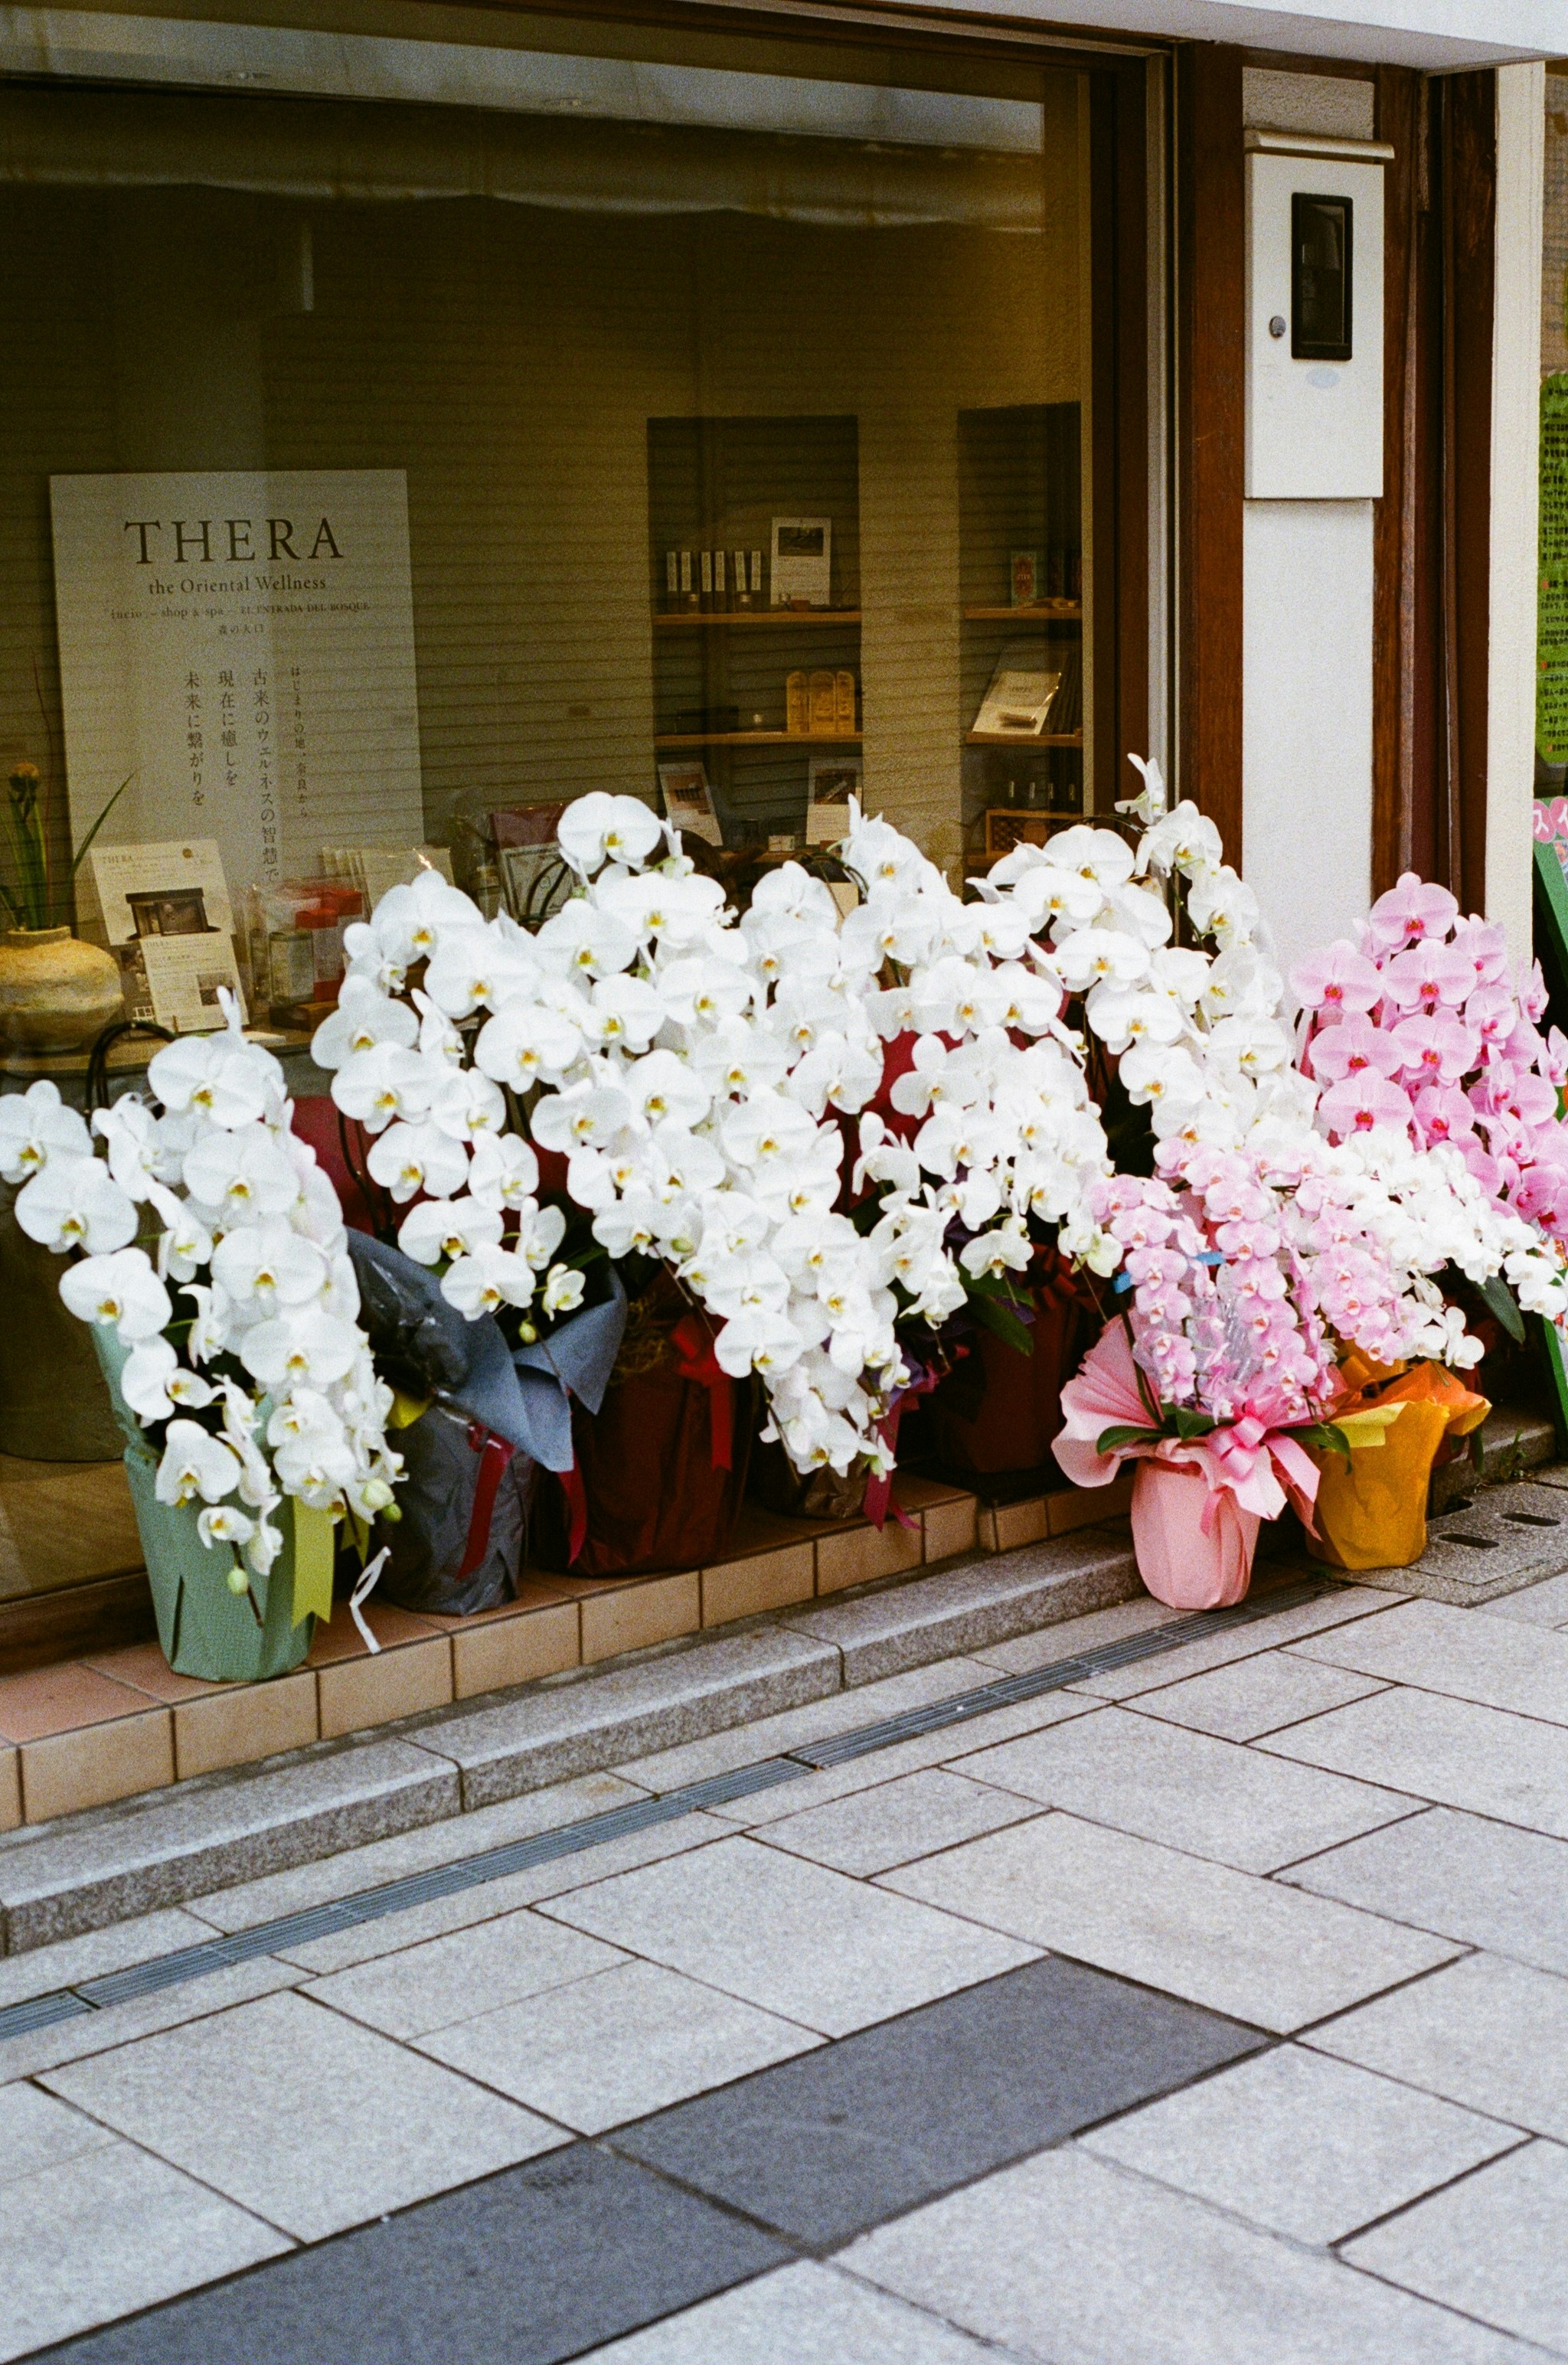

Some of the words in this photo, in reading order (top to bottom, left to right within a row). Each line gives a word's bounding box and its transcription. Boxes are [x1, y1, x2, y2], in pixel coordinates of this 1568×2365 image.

[123, 517, 344, 565] THERA
[149, 579, 174, 596] the
[181, 576, 250, 594] Oriental
[255, 573, 326, 592] Wellness
[162, 606, 189, 620] shop
[204, 607, 224, 619] spa
[330, 601, 370, 613] BOSQUE
[184, 671, 205, 806] 未来に繋がりを
[217, 669, 238, 786] 現在に癒しを
